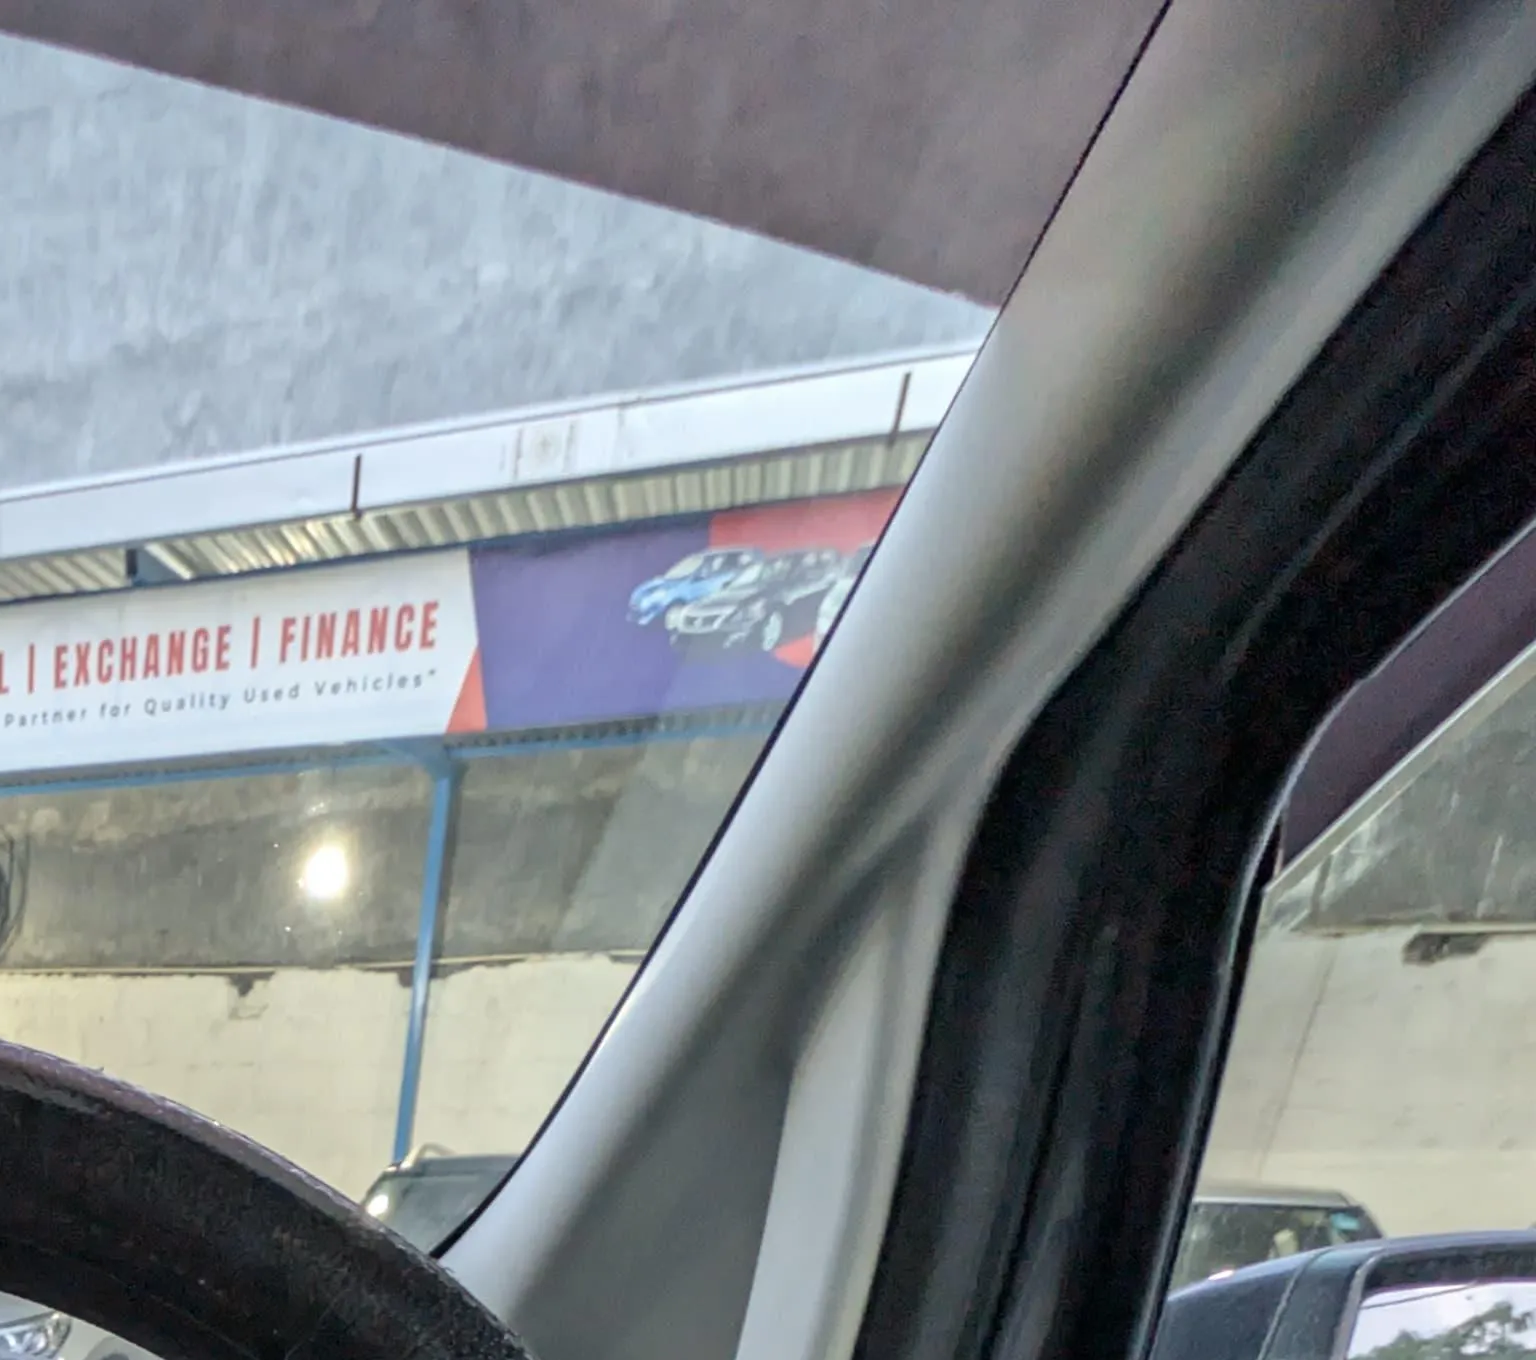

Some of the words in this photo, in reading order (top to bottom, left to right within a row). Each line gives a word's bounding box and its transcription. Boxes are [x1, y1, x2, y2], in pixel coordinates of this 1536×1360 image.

[54, 625, 231, 690] EXCHANGE
[279, 600, 439, 664] FINANCE
[4, 706, 87, 728] Partner
[100, 702, 131, 718] for
[144, 692, 230, 717] Quality
[244, 684, 300, 704] Used
